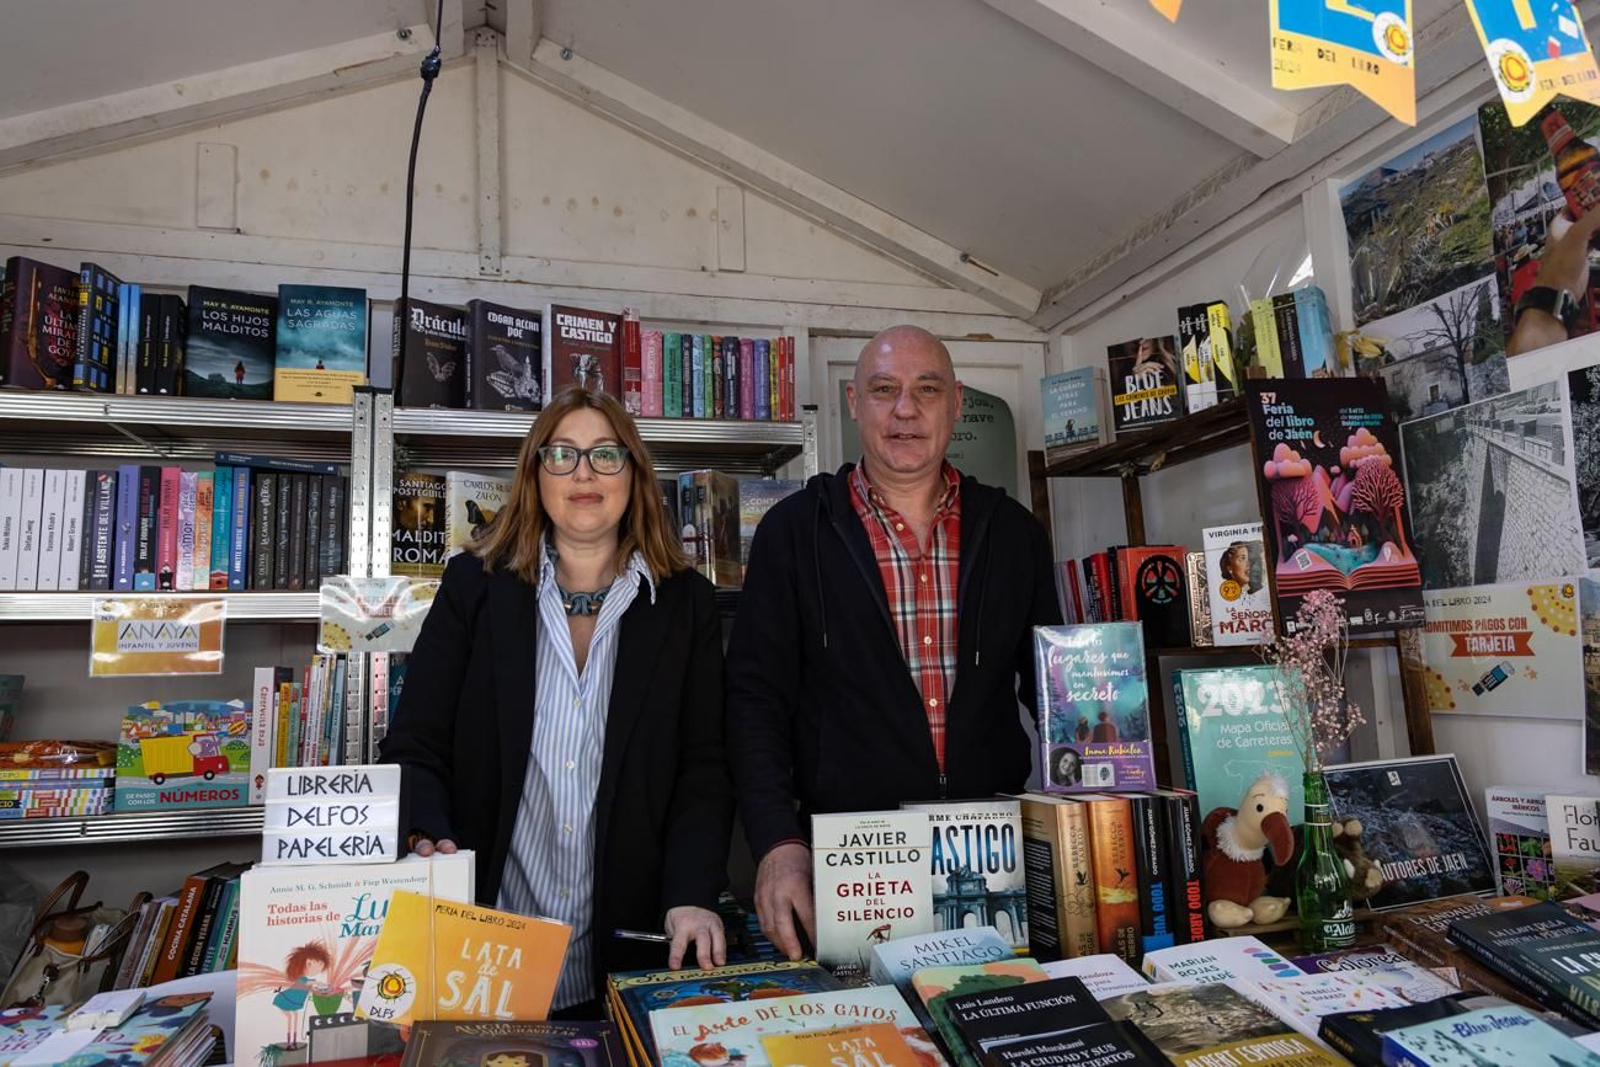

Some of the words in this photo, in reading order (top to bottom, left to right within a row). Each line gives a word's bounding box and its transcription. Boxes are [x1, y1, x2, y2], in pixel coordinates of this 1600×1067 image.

[202, 310, 228, 322] LOS
[232, 312, 270, 327] HIJOS
[230, 304, 270, 315] AYAMONTE
[286, 308, 310, 317] LAS
[314, 309, 357, 320] AGUAS
[202, 321, 269, 338] MALDITOS
[288, 319, 355, 331] SAGRADAS
[487, 312, 514, 326] EDGAR
[515, 318, 540, 332] ALLAN
[556, 313, 605, 332] CRIMEN
[608, 321, 617, 333] Y
[507, 326, 523, 339] POE
[560, 326, 613, 344] CASTIGO
[1059, 383, 1085, 392] CUENTA
[1260, 392, 1276, 404] 37
[1123, 395, 1173, 422] JEANS
[1262, 402, 1294, 415] Feria
[1266, 415, 1285, 428] del
[1286, 415, 1315, 427] libro
[1268, 428, 1284, 440] de
[463, 479, 494, 490] CARLOS
[475, 490, 502, 502] ZAFÓN
[99, 512, 109, 525] DEL
[140, 518, 149, 541] DONOVAN
[182, 522, 192, 549] amor
[392, 529, 446, 544] MALDIT
[1209, 528, 1249, 538] VIRGINIA
[25, 535, 33, 552] Stefan
[47, 531, 55, 552] Yasmina
[67, 535, 75, 552] Robert
[96, 527, 108, 563] ASISTENTE
[139, 541, 148, 560] FINLAY
[1449, 597, 1472, 606] LIBRO
[119, 622, 197, 640] ANAYA
[1475, 618, 1505, 631] PAGOS
[1508, 616, 1527, 630] CON
[1465, 635, 1516, 652] TARJETA
[1047, 645, 1108, 670] lugares
[1111, 652, 1130, 664] que
[1066, 681, 1121, 702] secreto
[1197, 680, 1290, 717] 2023
[1174, 682, 1186, 728] 2023
[1220, 722, 1251, 735] Mapa
[1254, 720, 1290, 732] Oficial
[1217, 737, 1232, 748] de
[1235, 735, 1293, 748] Carreteras
[287, 769, 373, 796] LIBRERÍA
[159, 787, 240, 804] NÚMEROS
[286, 805, 369, 827] DELFOS
[1147, 808, 1155, 824] JUAN
[1183, 806, 1192, 822] JUAN
[277, 831, 385, 859] PAPELERÍA
[838, 831, 907, 848] JAVIER
[1069, 825, 1077, 869] REBECCA
[1184, 823, 1195, 874] GÓMEZ-JURADO
[826, 849, 920, 867] CASTILLO
[931, 823, 1016, 876] ASTIGO
[1148, 825, 1159, 876] GÓMEZ-JURADO
[1380, 860, 1427, 883] AUTORES
[1429, 857, 1443, 874] DE
[269, 886, 293, 894] Annie
[319, 881, 352, 890] Schmidt
[362, 879, 380, 888] Fiep
[382, 876, 427, 886] Westendorp
[837, 880, 913, 898] GRIETA
[865, 898, 886, 906] DEL
[1150, 881, 1165, 911] TODO
[1186, 880, 1201, 909] TODO
[268, 903, 306, 915] Todas
[310, 901, 328, 912] las
[837, 907, 914, 922] SILENCIO
[167, 929, 182, 961] COCINA
[178, 886, 198, 929] CATALANA
[267, 913, 324, 926] historias
[325, 911, 341, 922] de
[435, 905, 459, 917] FERIA
[461, 910, 477, 921] DEL
[479, 912, 504, 927] LIBRO
[506, 918, 526, 930] 2024
[1152, 914, 1166, 936] VUE
[223, 910, 239, 945] HUMMUS
[1188, 913, 1204, 942] ARDE
[190, 939, 204, 965] COCINA
[460, 938, 522, 969] LATA
[914, 936, 977, 954] MIKEL
[900, 946, 1003, 971] SANTIAGO
[1168, 955, 1217, 970] MARIAN
[1551, 956, 1591, 974] LA
[1178, 965, 1220, 978] ROJAS
[439, 969, 514, 1020] SAL
[956, 1000, 976, 1010] Luis
[977, 995, 1014, 1007] Landero
[369, 1006, 395, 1018] DLFS
[962, 1011, 980, 1021] LA
[981, 1004, 1025, 1018] ÚLTIMA
[1026, 993, 1077, 1011] FUNCIÓN
[672, 1025, 691, 1037] EL
[693, 1014, 753, 1041] Arte
[756, 1006, 782, 1022] DE
[788, 1003, 826, 1017] LOS
[834, 1003, 900, 1022] GATOS
[1450, 1020, 1489, 1038] Blue
[828, 1036, 877, 1053] LATA
[1002, 1049, 1036, 1061] Haruki
[1038, 1039, 1085, 1054] Murakami
[1184, 1051, 1241, 1067] ALBERT
[1236, 1038, 1312, 1063] ESPINOSA
[831, 1051, 893, 1067] SAL
[1030, 1053, 1081, 1067] CIUDAD
[1082, 1051, 1091, 1061] Y
[1092, 1042, 1118, 1058] SUS
